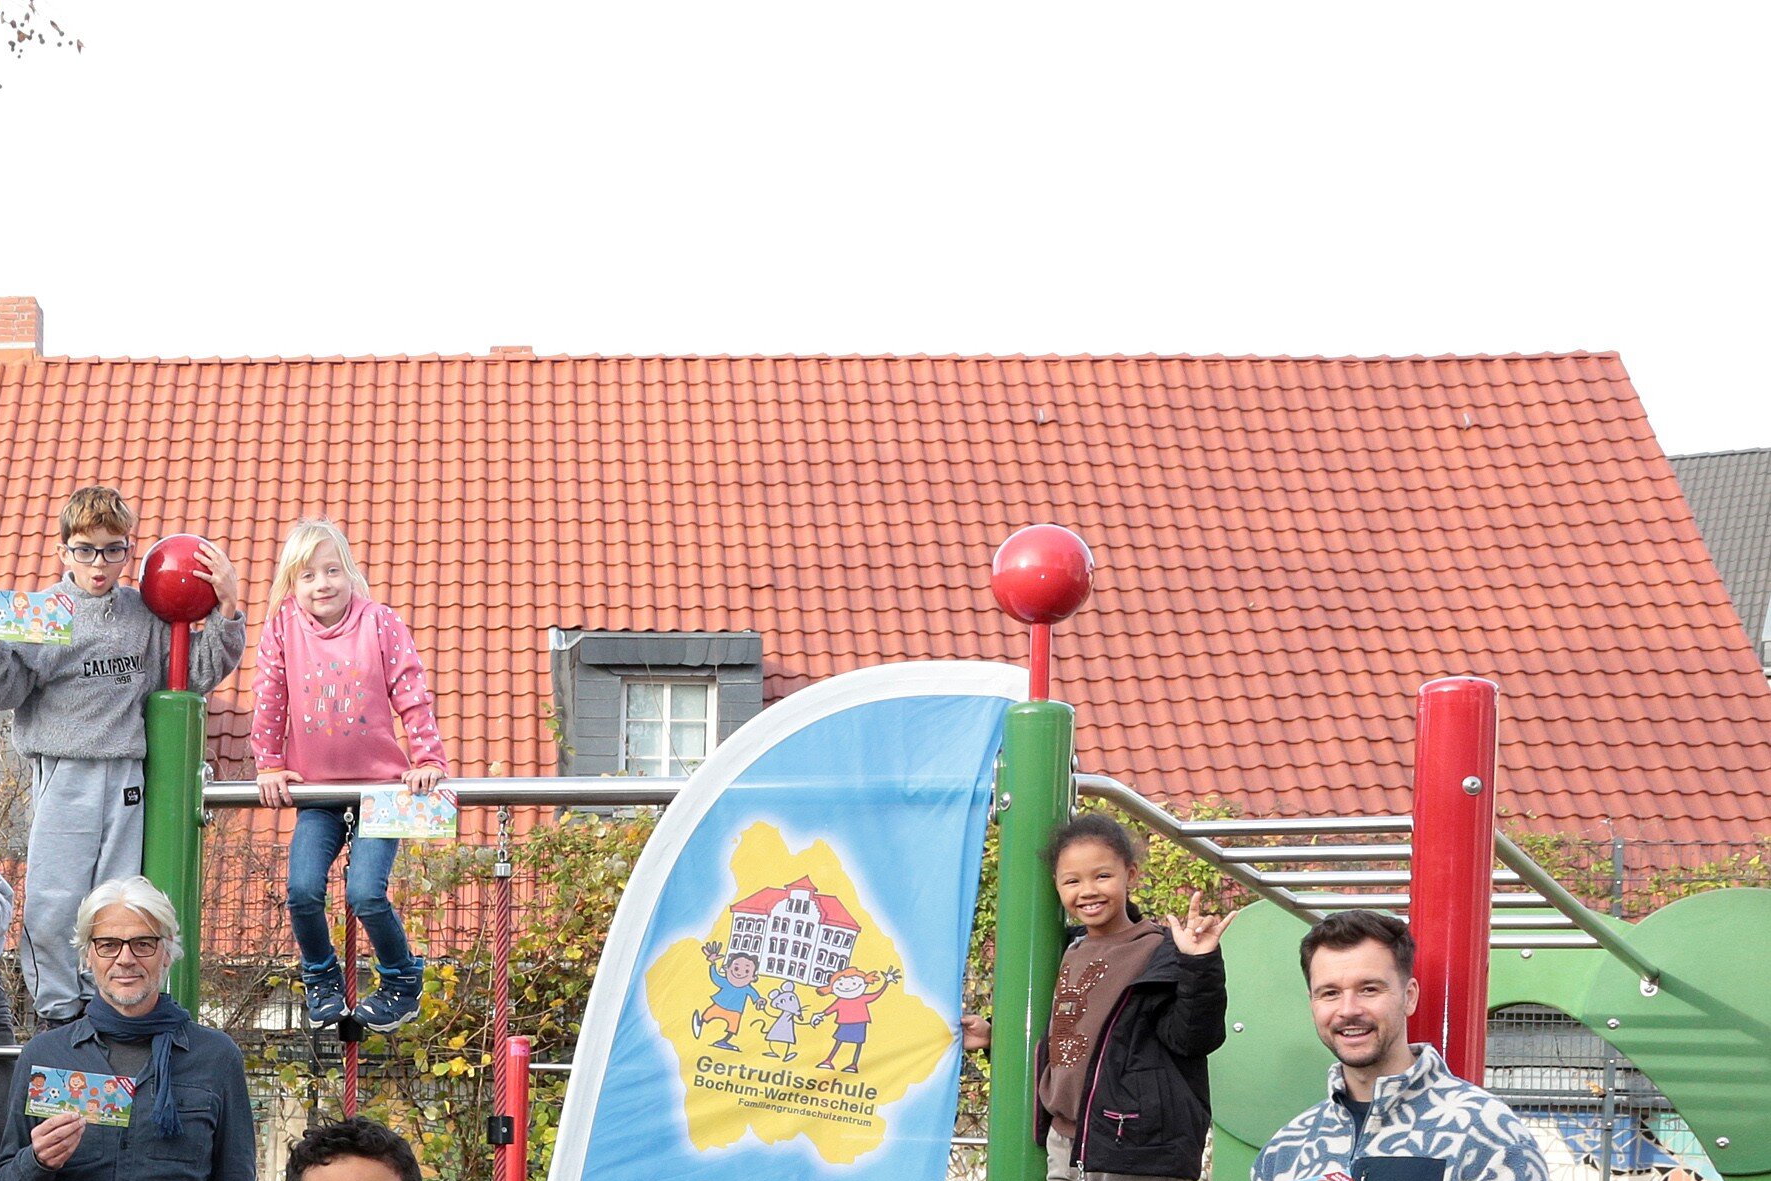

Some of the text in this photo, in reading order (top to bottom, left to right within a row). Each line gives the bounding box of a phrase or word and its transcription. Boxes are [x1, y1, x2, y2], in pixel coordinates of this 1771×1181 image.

[694, 1074, 875, 1116] Bochum-Wattenscheid
[696, 1055, 878, 1100] Gertrudisschule
[738, 1097, 872, 1127] Familiengrundschulzentrum
